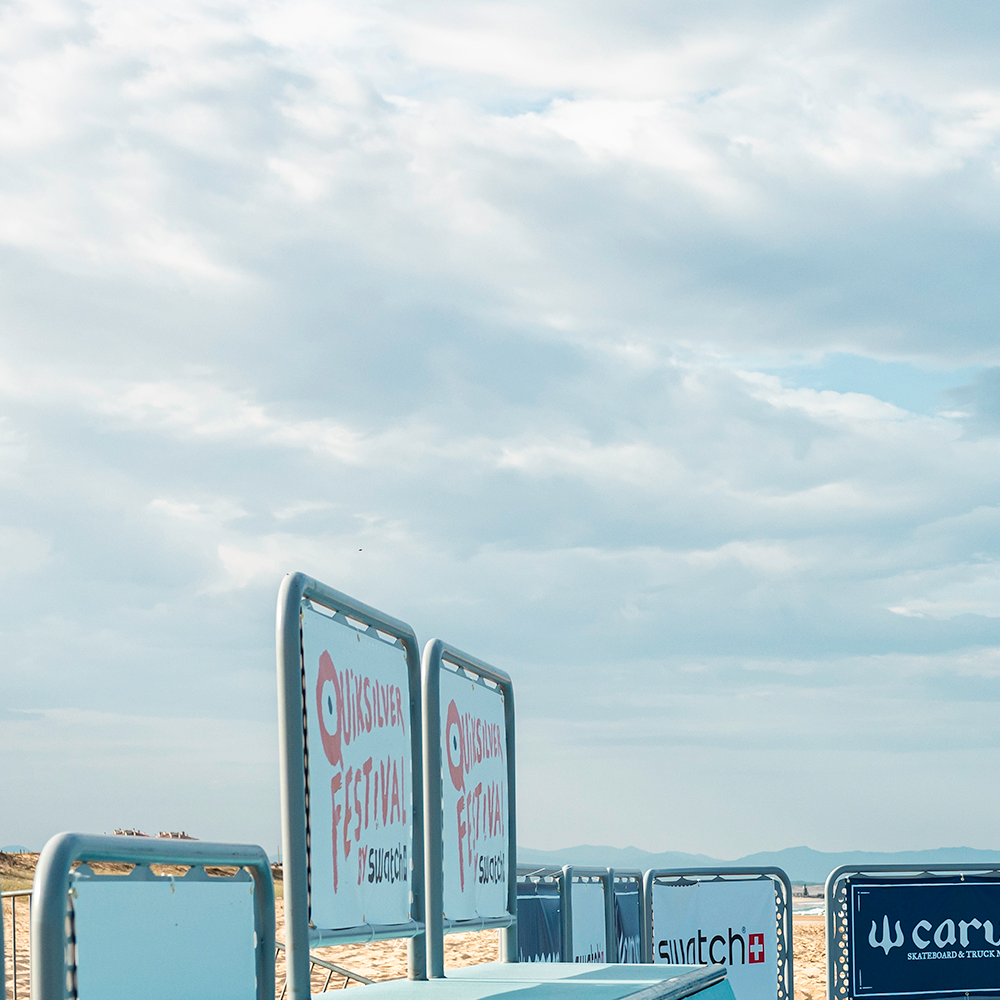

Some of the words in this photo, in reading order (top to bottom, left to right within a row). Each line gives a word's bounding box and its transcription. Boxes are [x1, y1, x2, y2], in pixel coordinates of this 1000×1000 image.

[331, 755, 406, 894] FESTIVAL
[457, 780, 504, 892] FESTIVAL
[358, 845, 368, 885] BY
[658, 928, 745, 965] swatch
[907, 951, 957, 960] SKATEBOARD
[966, 950, 996, 958] TRUCK
